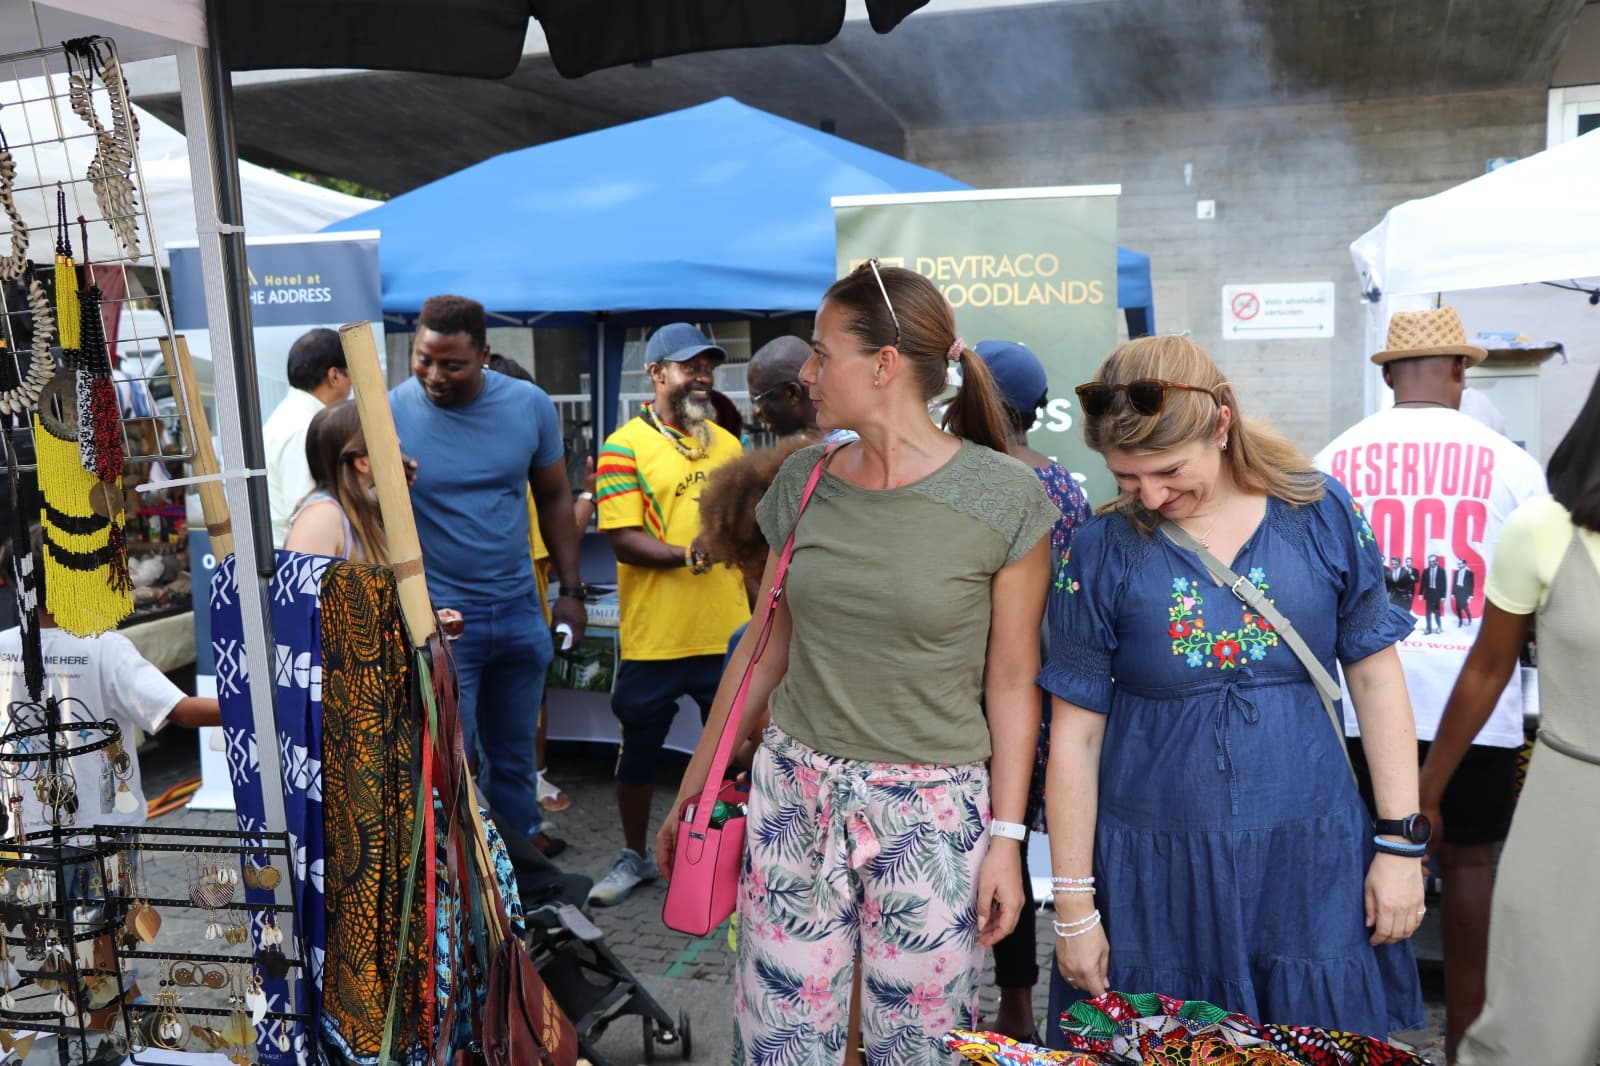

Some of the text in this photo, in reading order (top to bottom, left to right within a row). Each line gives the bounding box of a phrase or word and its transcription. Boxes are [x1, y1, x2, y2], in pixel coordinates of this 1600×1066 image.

[916, 253, 1059, 280] DEVTRACO
[264, 274, 320, 286] Hotel at
[249, 287, 332, 305] HE ADDRESS
[938, 279, 1105, 309] OODLANDS
[1331, 442, 1495, 500] RESERVOIR
[1356, 497, 1488, 619] OGS
[1427, 642, 1474, 652] WOR
[59, 656, 89, 665] HERE
